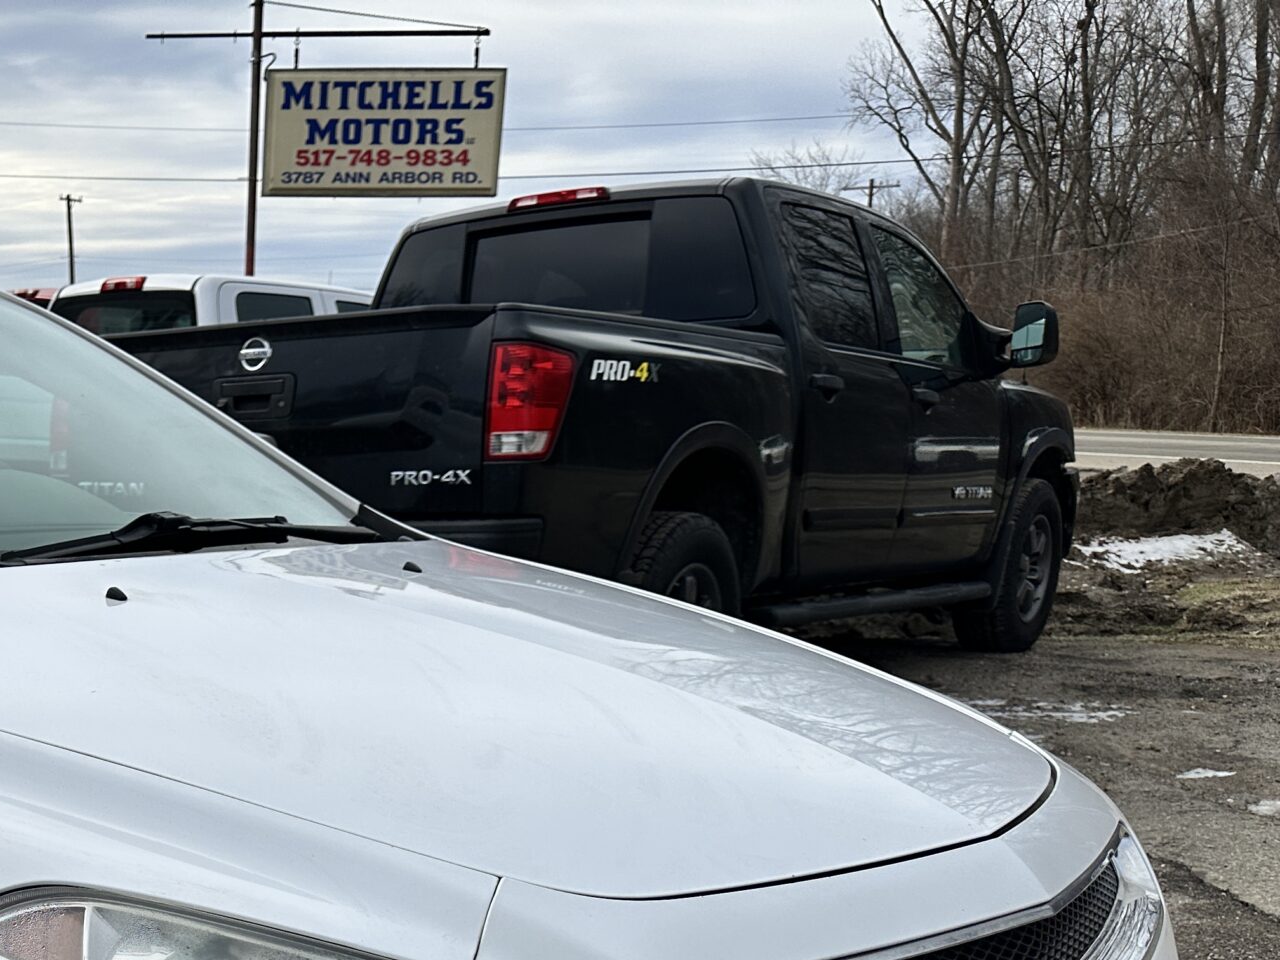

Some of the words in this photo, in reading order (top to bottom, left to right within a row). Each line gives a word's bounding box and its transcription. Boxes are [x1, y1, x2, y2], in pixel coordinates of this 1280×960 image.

[280, 80, 496, 111] MITCHELLS
[304, 117, 466, 145] MOTORS
[295, 149, 471, 167] 517-748-9834
[280, 171, 325, 184] 3787
[331, 171, 371, 184] ANN
[378, 171, 444, 184] ARBOR
[451, 171, 483, 184] RD.
[590, 359, 661, 382] PRO-4X
[390, 469, 472, 486] PRO-4X
[78, 481, 145, 496] TITAN
